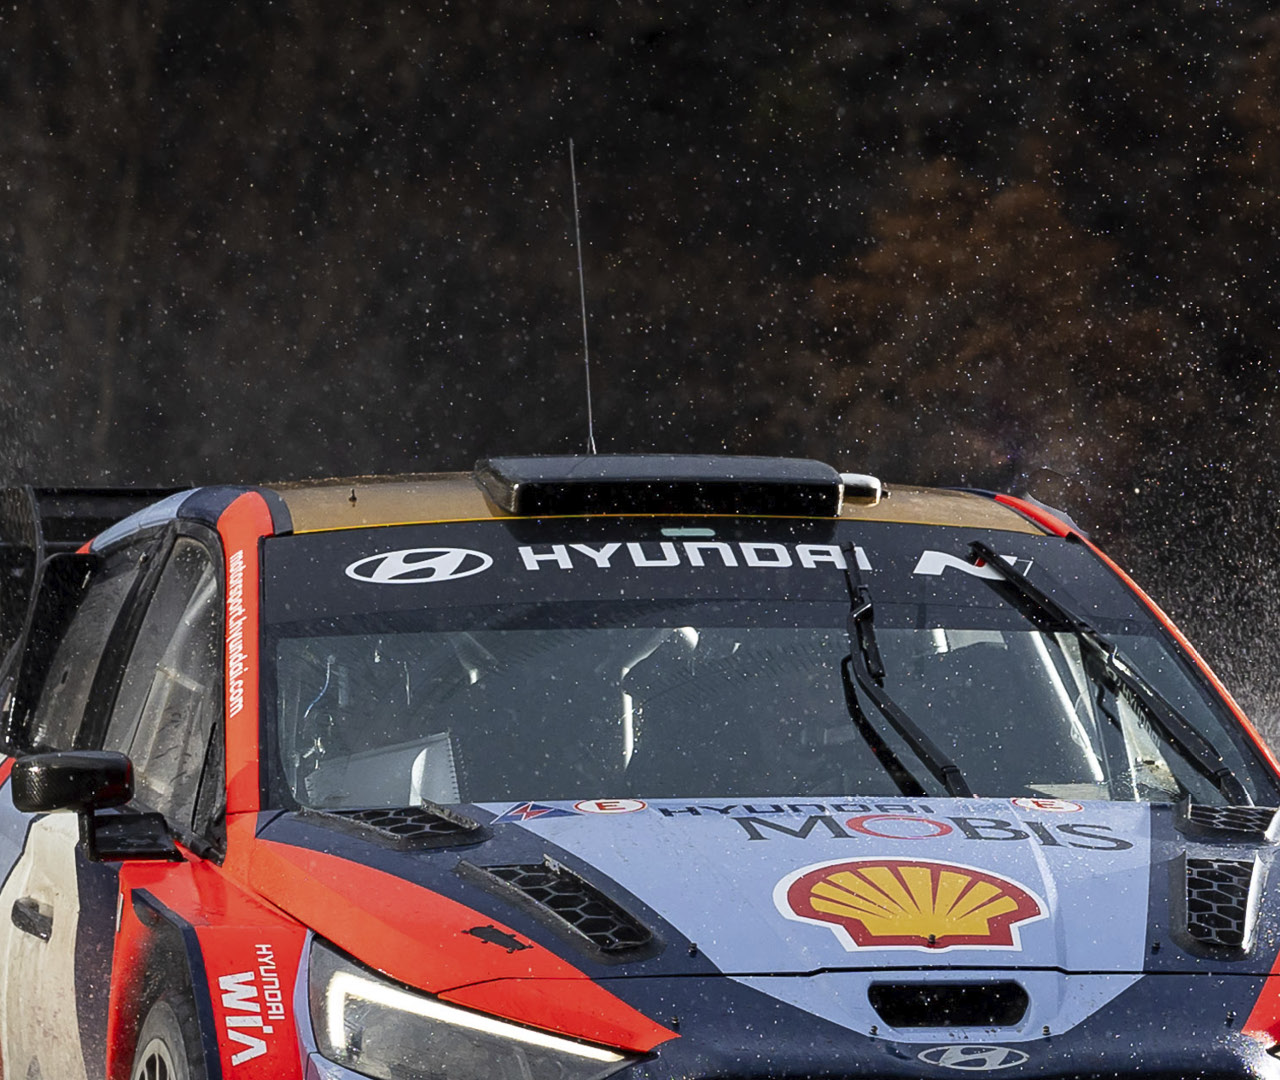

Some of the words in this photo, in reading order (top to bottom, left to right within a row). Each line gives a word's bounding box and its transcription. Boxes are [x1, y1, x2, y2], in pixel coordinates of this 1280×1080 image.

[518, 541, 873, 571] HYUNDAI
[226, 549, 249, 718] motorsport.hyundai.com
[595, 800, 627, 811] E
[657, 803, 935, 817] HYUNDAI
[1030, 799, 1065, 810] E
[729, 814, 1135, 851] MOBIS
[255, 944, 285, 1020] HYUNDAI
